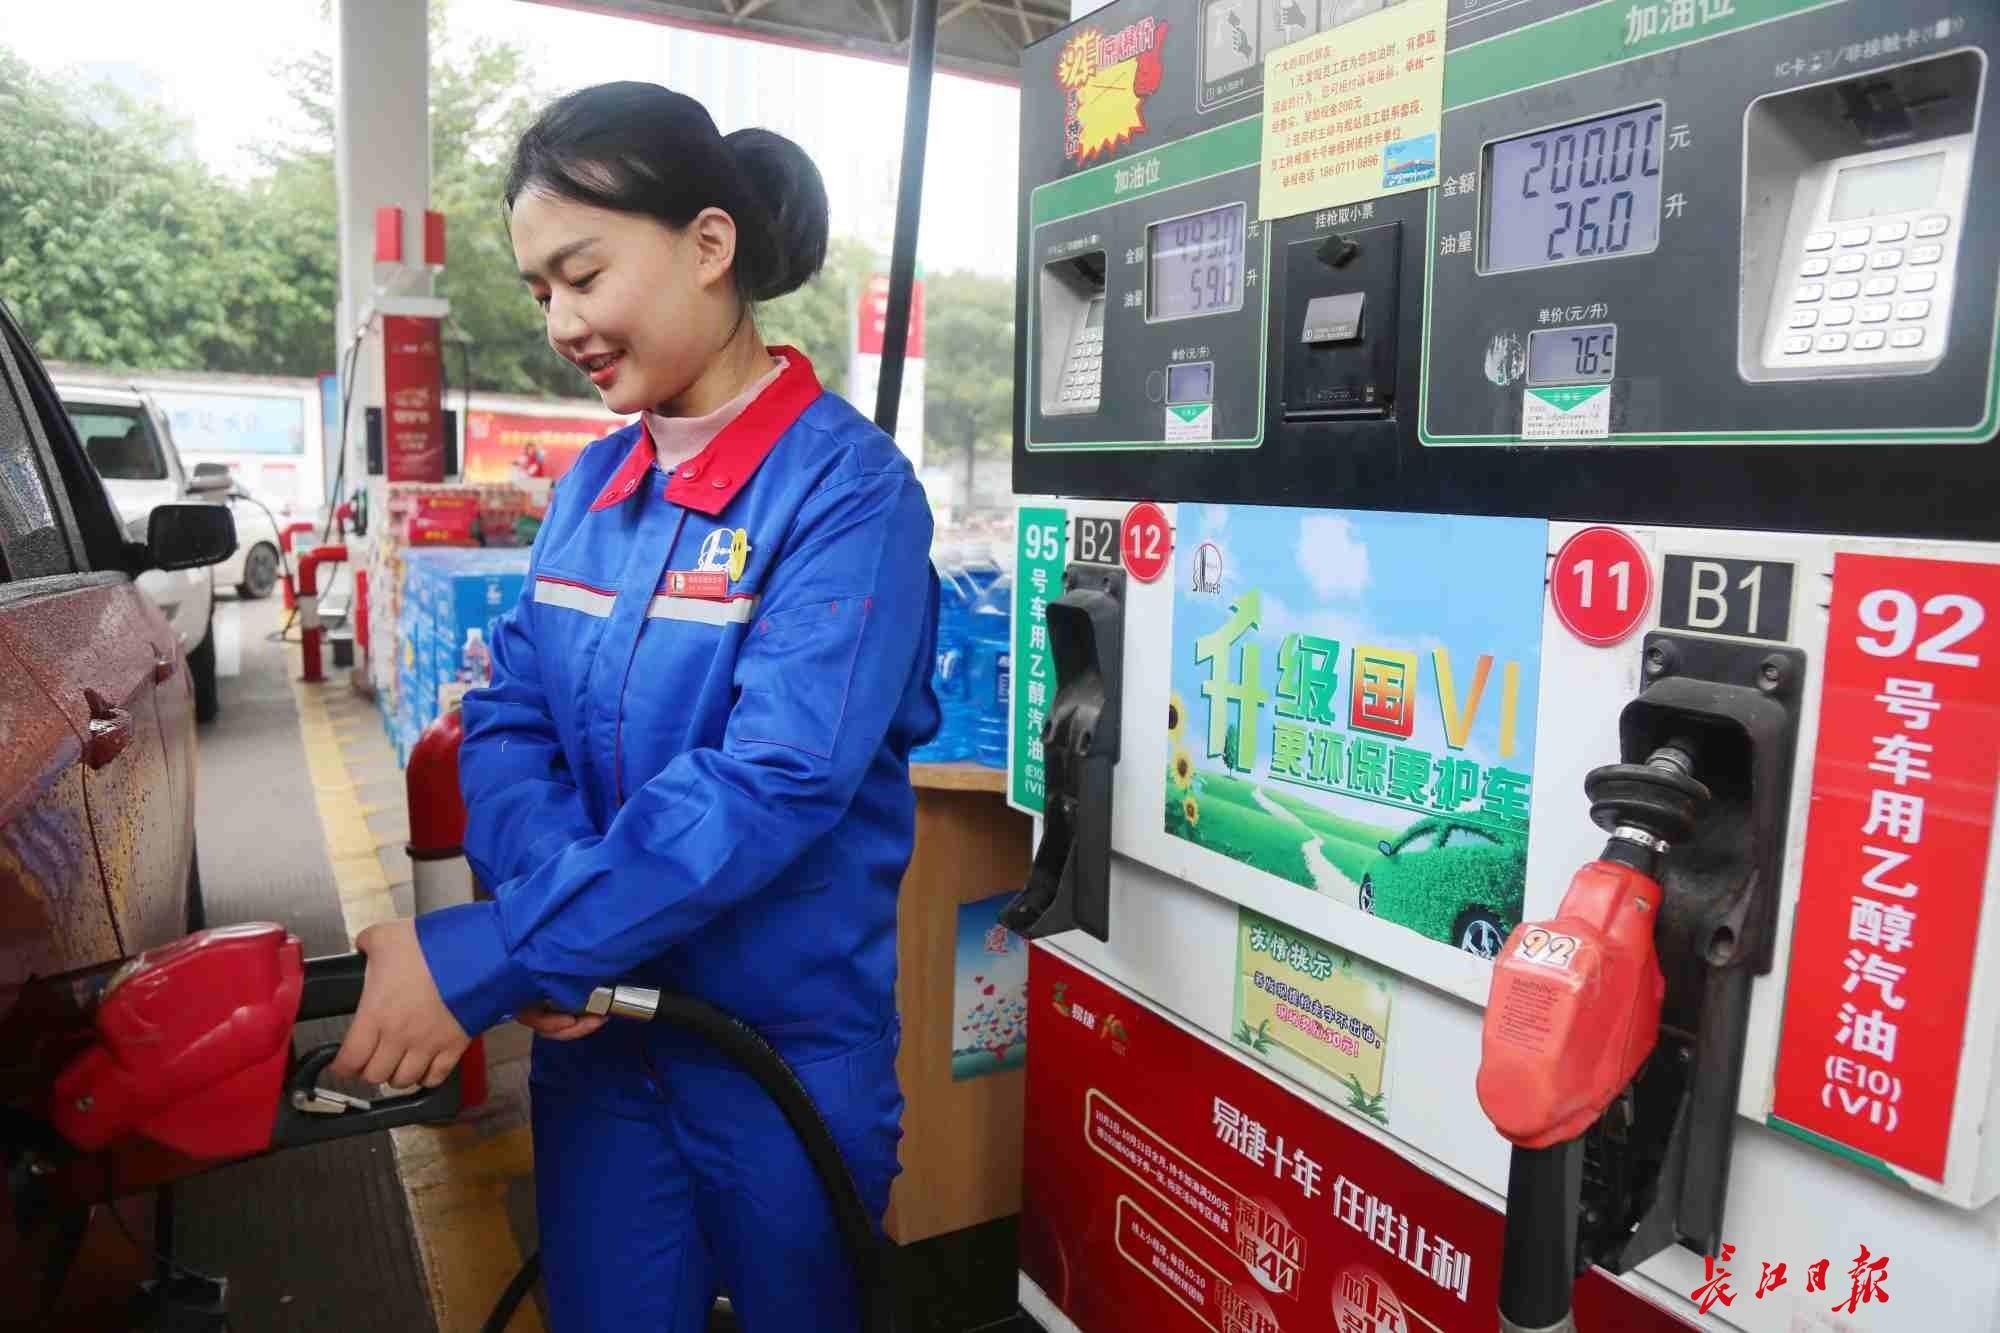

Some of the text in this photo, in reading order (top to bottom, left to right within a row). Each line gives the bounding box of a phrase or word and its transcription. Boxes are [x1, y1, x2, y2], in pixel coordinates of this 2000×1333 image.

[1668, 124, 1692, 151] 元
[1114, 157, 1161, 194] 加油位
[1442, 171, 1477, 198] 金额
[1314, 201, 1376, 230] 挂枪取小票
[1664, 192, 1688, 219] 升
[1439, 230, 1473, 257] 油量
[1025, 523, 1060, 562] 95
[1081, 519, 1114, 563] B2
[1130, 524, 1162, 561] 12
[1572, 557, 1631, 613] 11
[1687, 560, 1764, 635] B1
[1855, 588, 1986, 669] 92
[1271, 722, 1532, 823] 更环保更护车
[1833, 676, 1942, 1064] 号车用乙醇汽油
[1522, 928, 1577, 967] 92
[1824, 1054, 1902, 1103] (E10)
[1820, 1082, 1899, 1134] (VI)
[1211, 1095, 1324, 1199] 易捷十年
[1333, 1173, 1472, 1303] 任性让利
